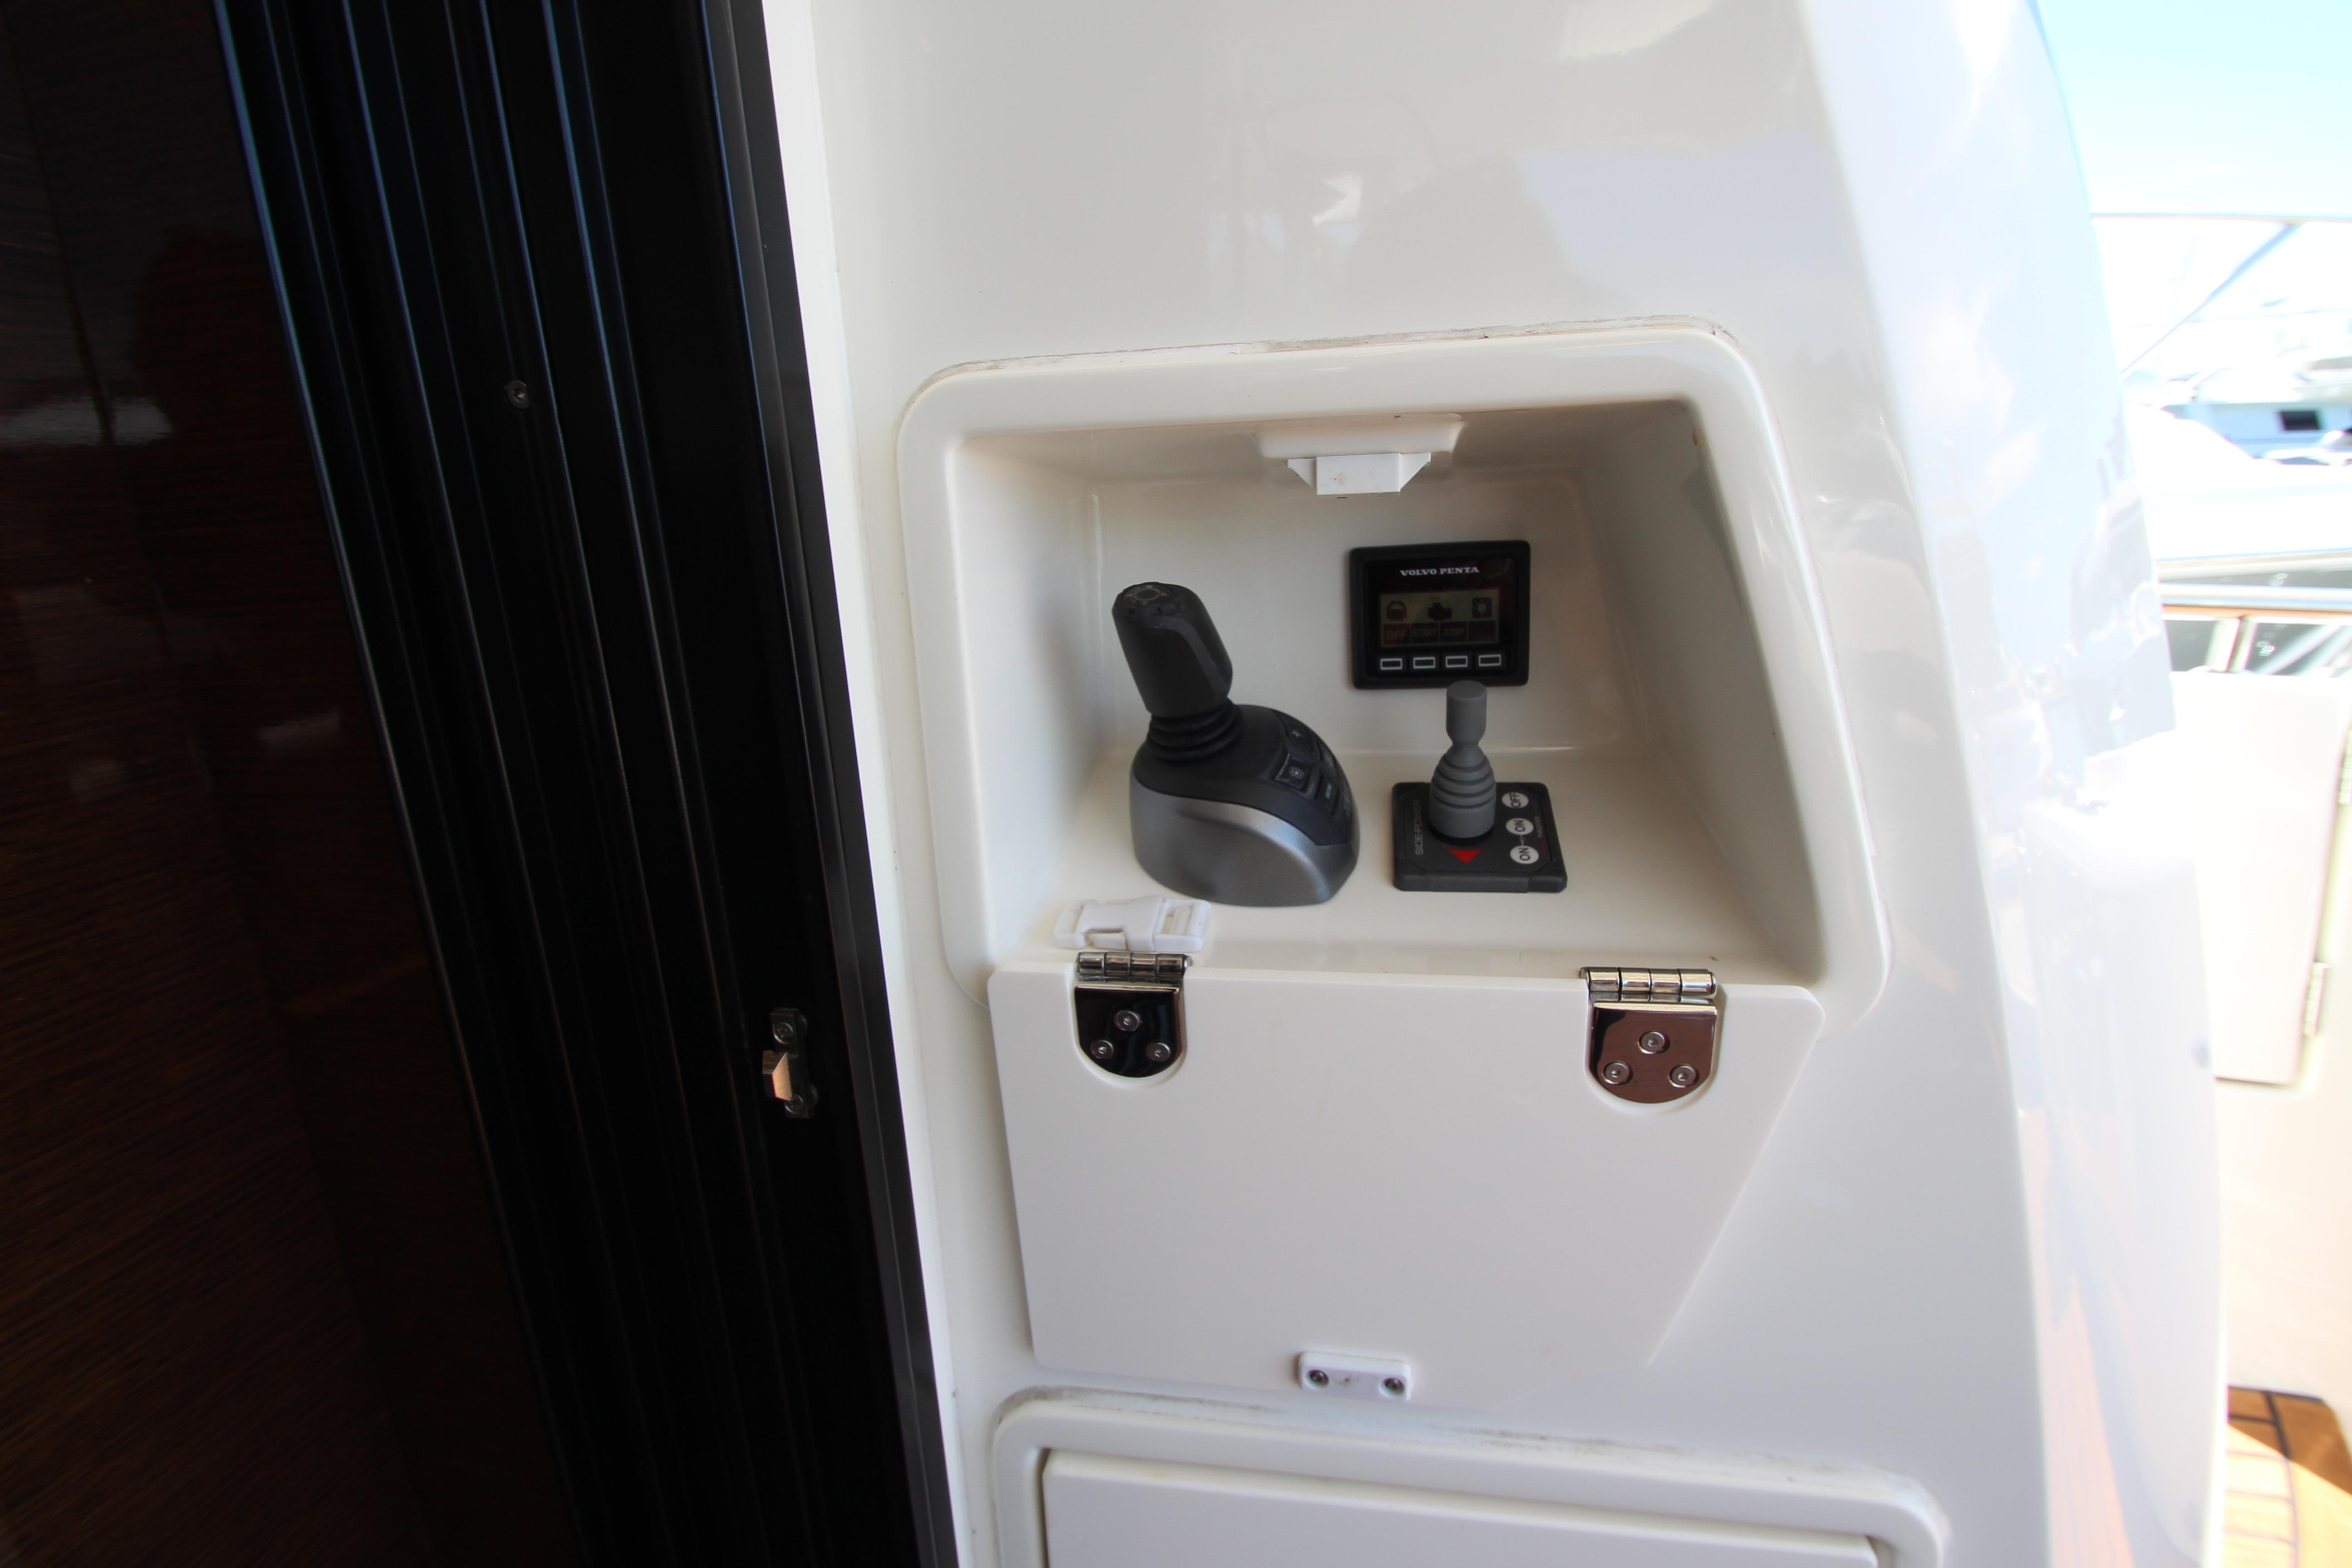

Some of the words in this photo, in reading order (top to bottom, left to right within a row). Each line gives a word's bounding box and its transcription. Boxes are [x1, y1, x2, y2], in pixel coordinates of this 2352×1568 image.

[1440, 567, 1480, 575] PENTA
[1412, 627, 1437, 637] START
[1509, 792, 1522, 808] OFF
[1515, 819, 1525, 833] ON
[1519, 847, 1531, 862] ON
